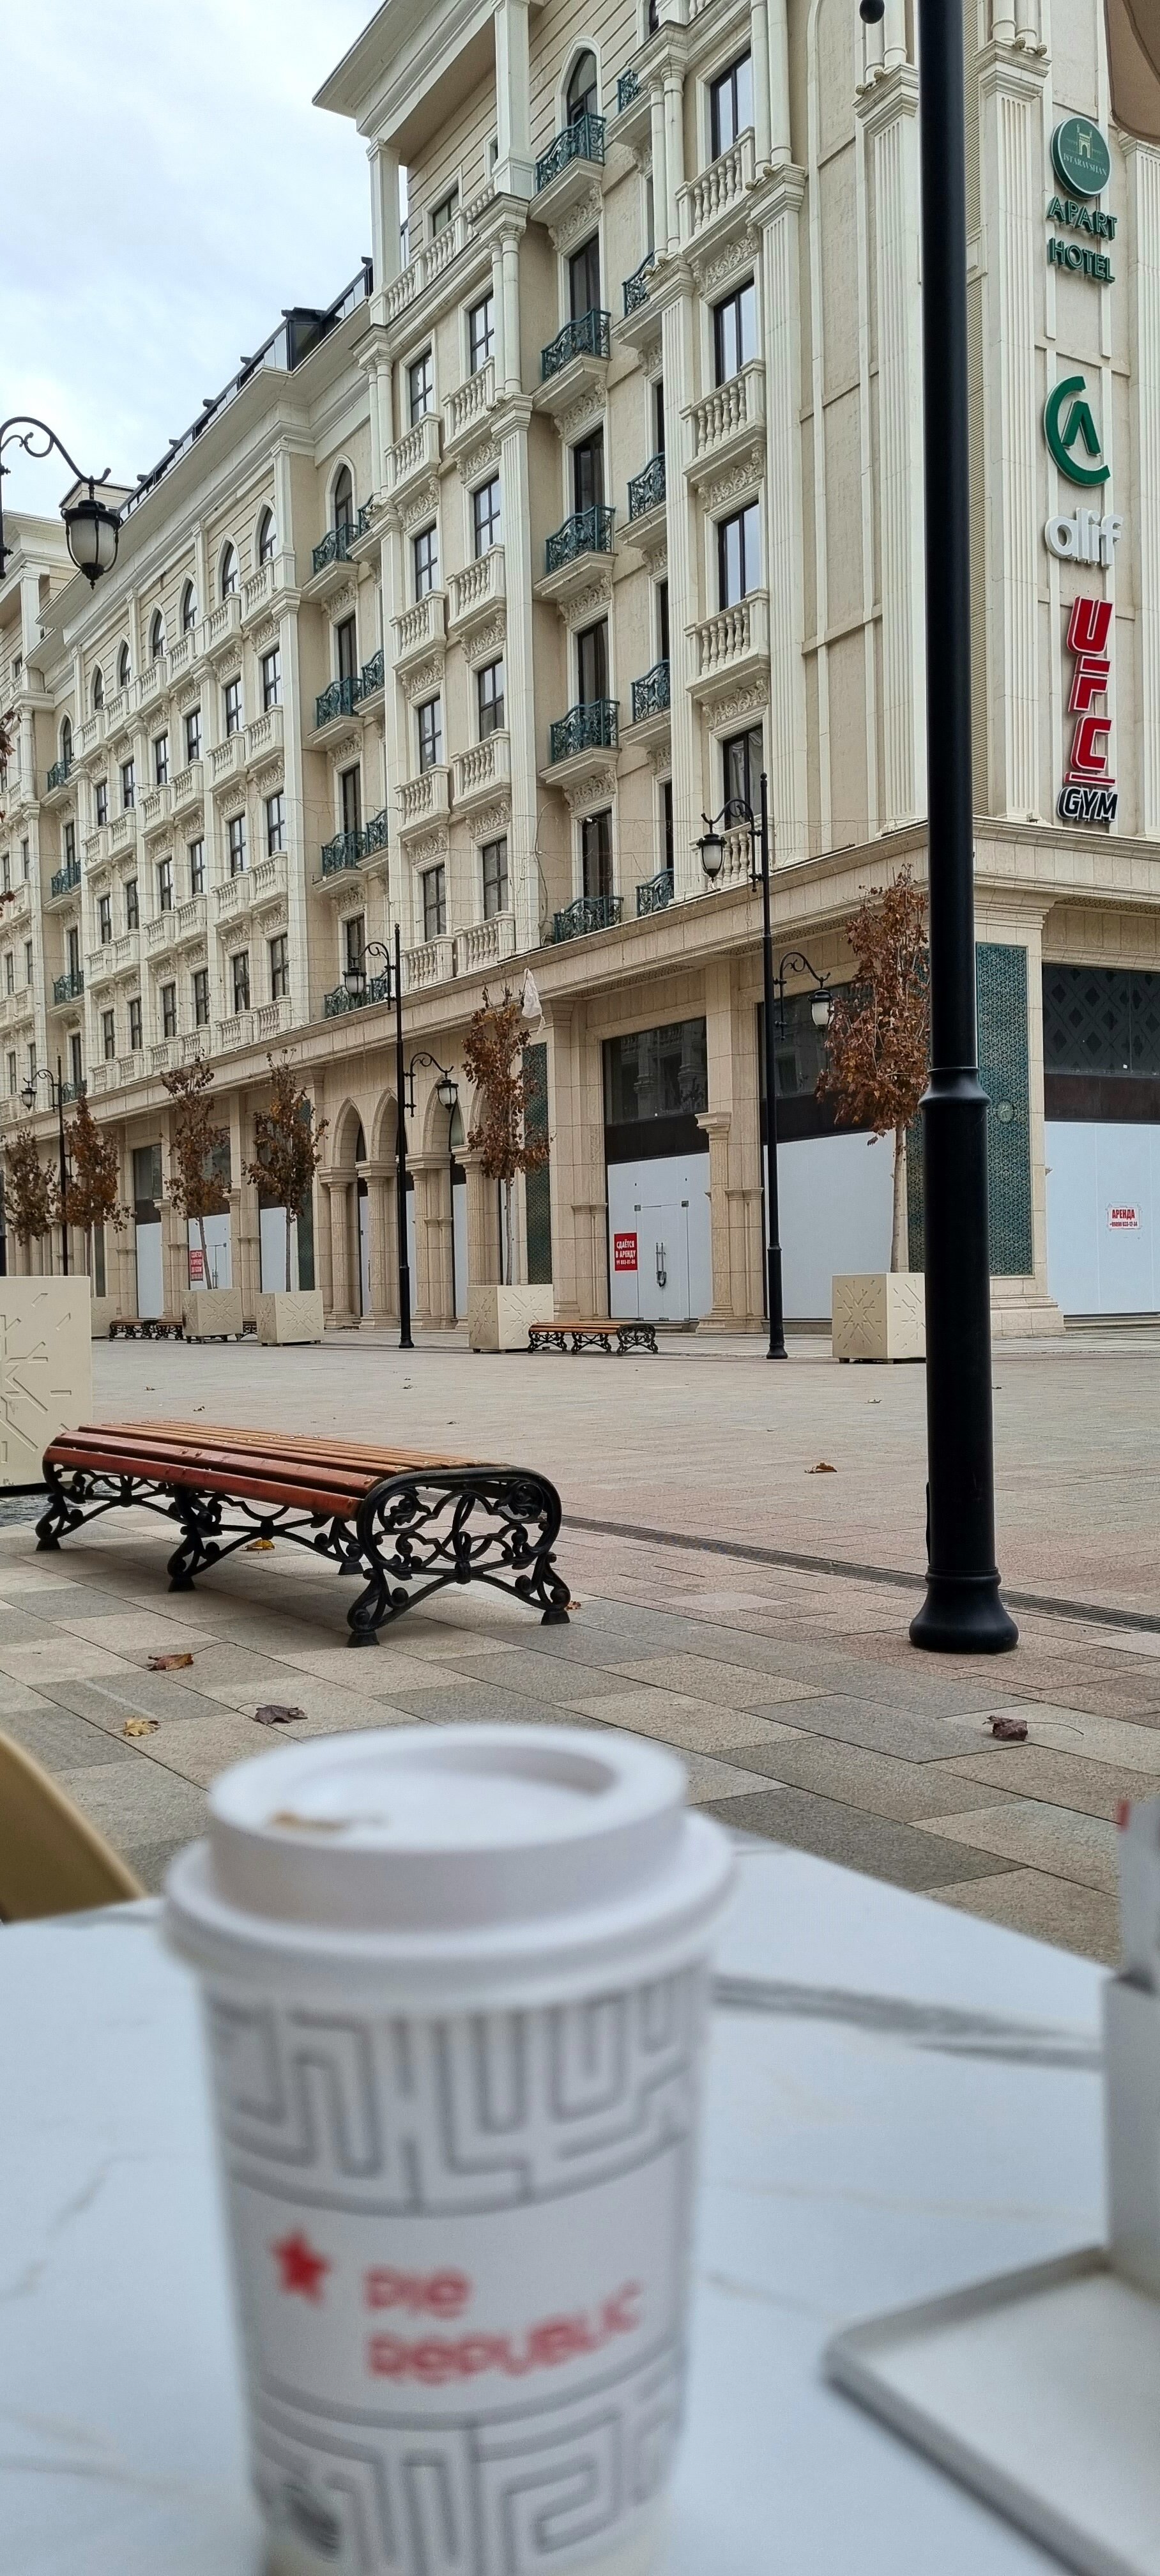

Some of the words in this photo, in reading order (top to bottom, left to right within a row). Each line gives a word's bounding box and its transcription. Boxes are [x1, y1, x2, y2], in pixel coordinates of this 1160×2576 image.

[1063, 153, 1107, 176] ISTARAVSHAN
[1046, 195, 1118, 241] APART
[1048, 237, 1115, 284] HOTEL
[1045, 507, 1124, 568] alif
[1067, 595, 1116, 771] UFC
[1057, 786, 1118, 822] GYM
[1112, 1209, 1135, 1220] АРЕНДА
[616, 1239, 634, 1249] СДАЁТСЯ
[620, 1250, 636, 1259] АРЕНДУ
